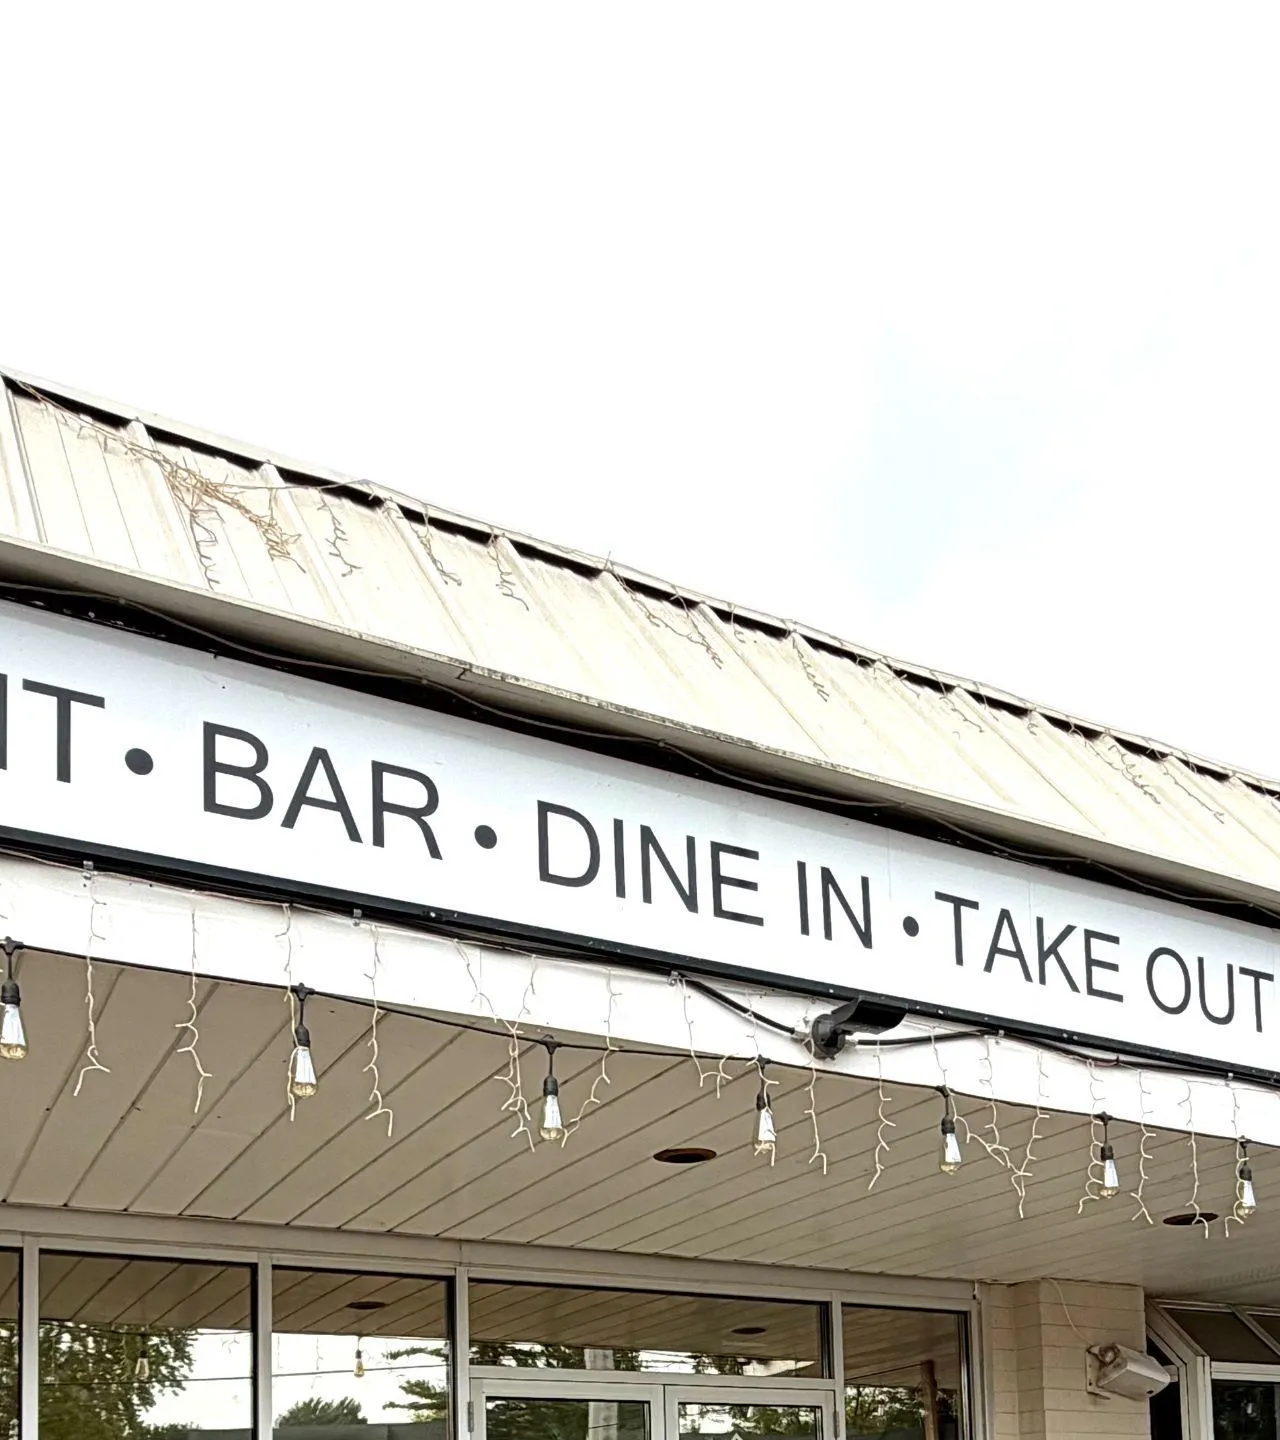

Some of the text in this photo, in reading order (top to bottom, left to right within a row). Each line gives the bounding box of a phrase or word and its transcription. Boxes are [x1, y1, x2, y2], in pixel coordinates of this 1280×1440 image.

[202, 720, 445, 862] BAR
[535, 799, 766, 928] DINE
[796, 859, 873, 951] IN
[934, 890, 1125, 1003] TAKE
[1145, 945, 1276, 1035] OUT
